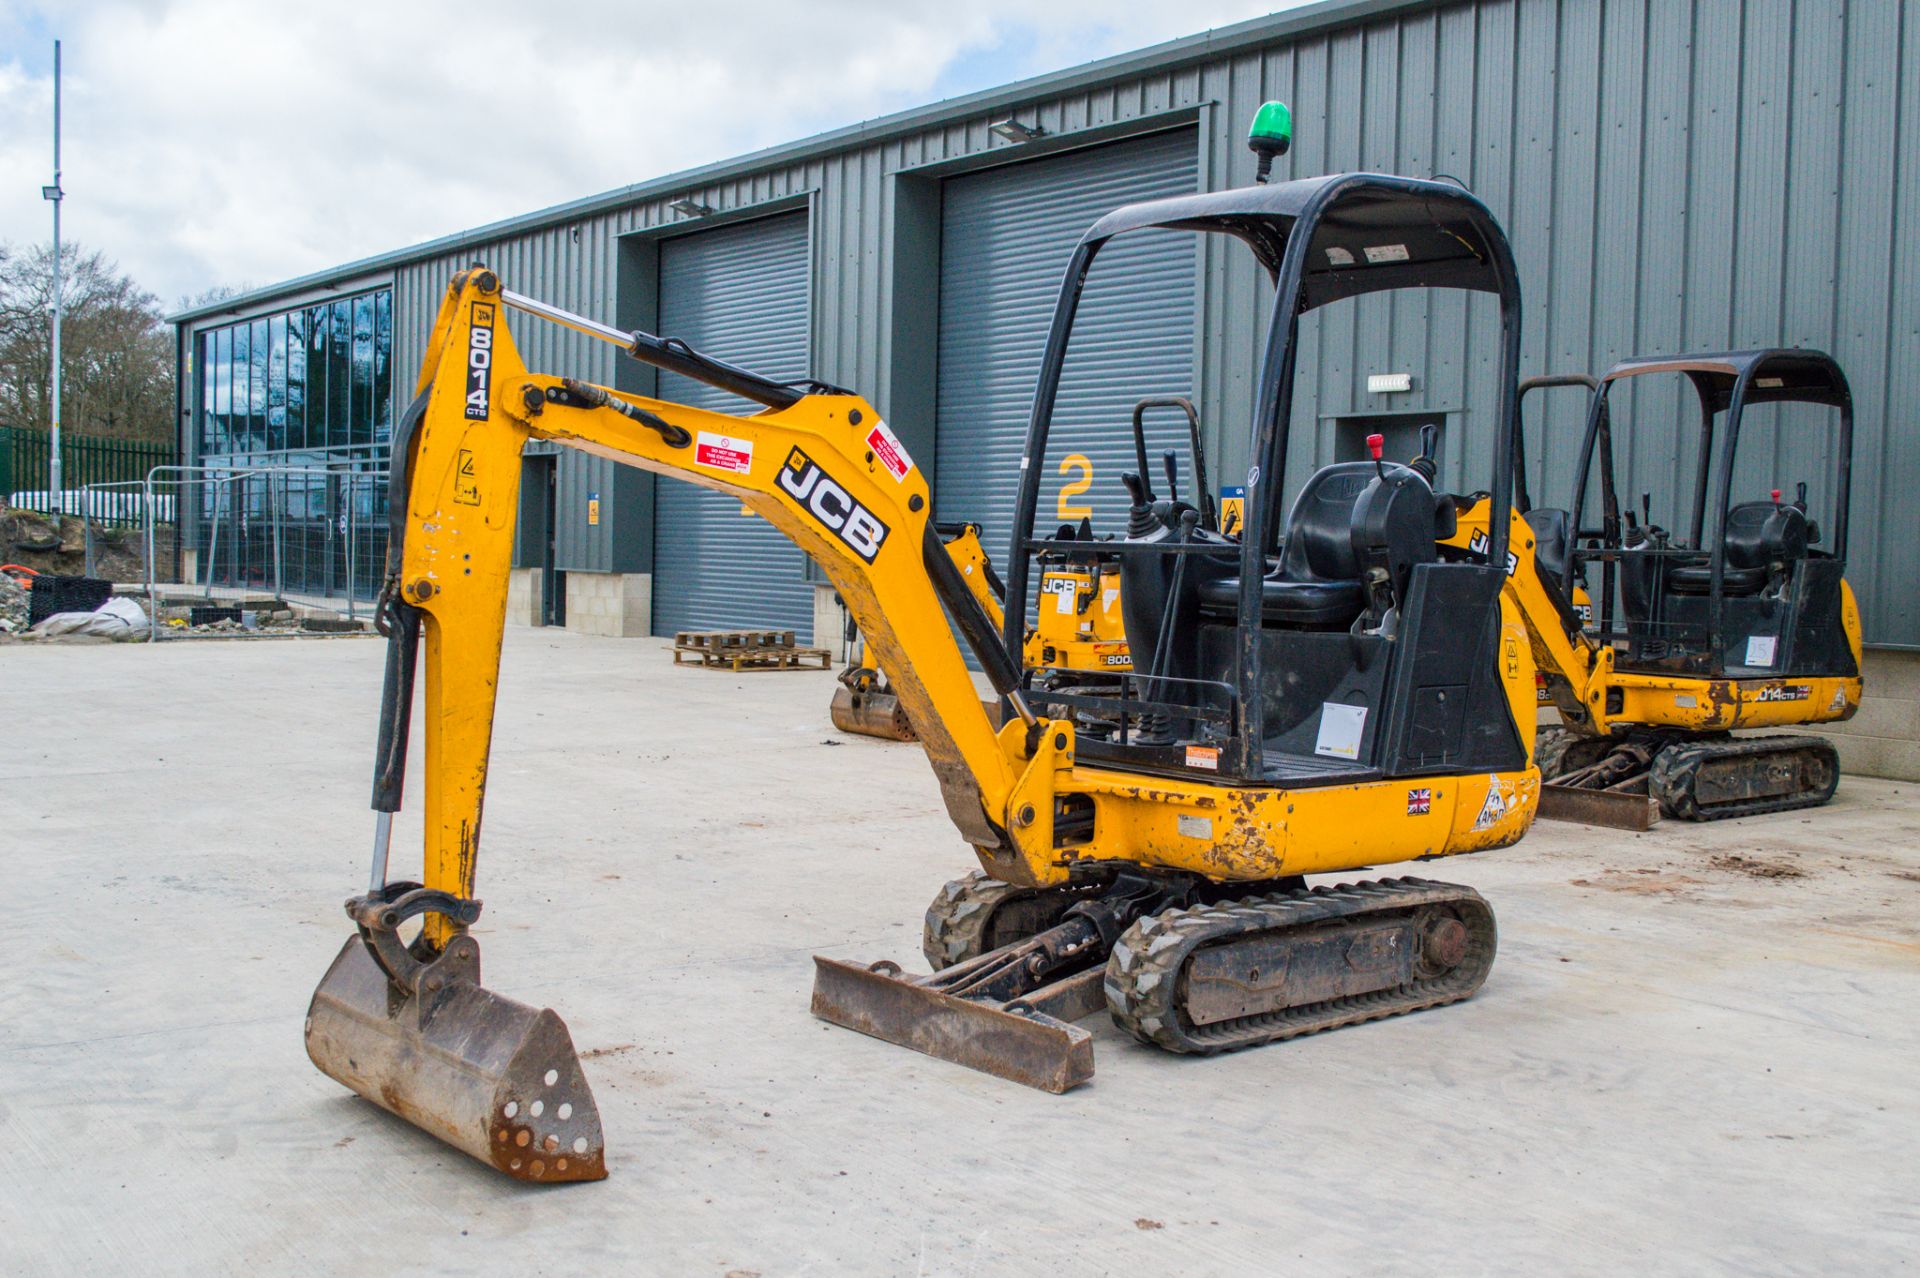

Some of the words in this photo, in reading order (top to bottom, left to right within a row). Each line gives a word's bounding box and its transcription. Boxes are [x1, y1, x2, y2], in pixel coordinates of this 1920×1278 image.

[467, 327, 491, 409] 8014
[466, 407, 487, 417] CTS
[1057, 454, 1093, 519] 2
[780, 465, 884, 557] JCB
[1470, 534, 1517, 575] JB
[1043, 579, 1076, 593] JCB
[1107, 655, 1133, 665] 800
[1755, 686, 1781, 701] 014
[1781, 692, 1796, 700] CTS
